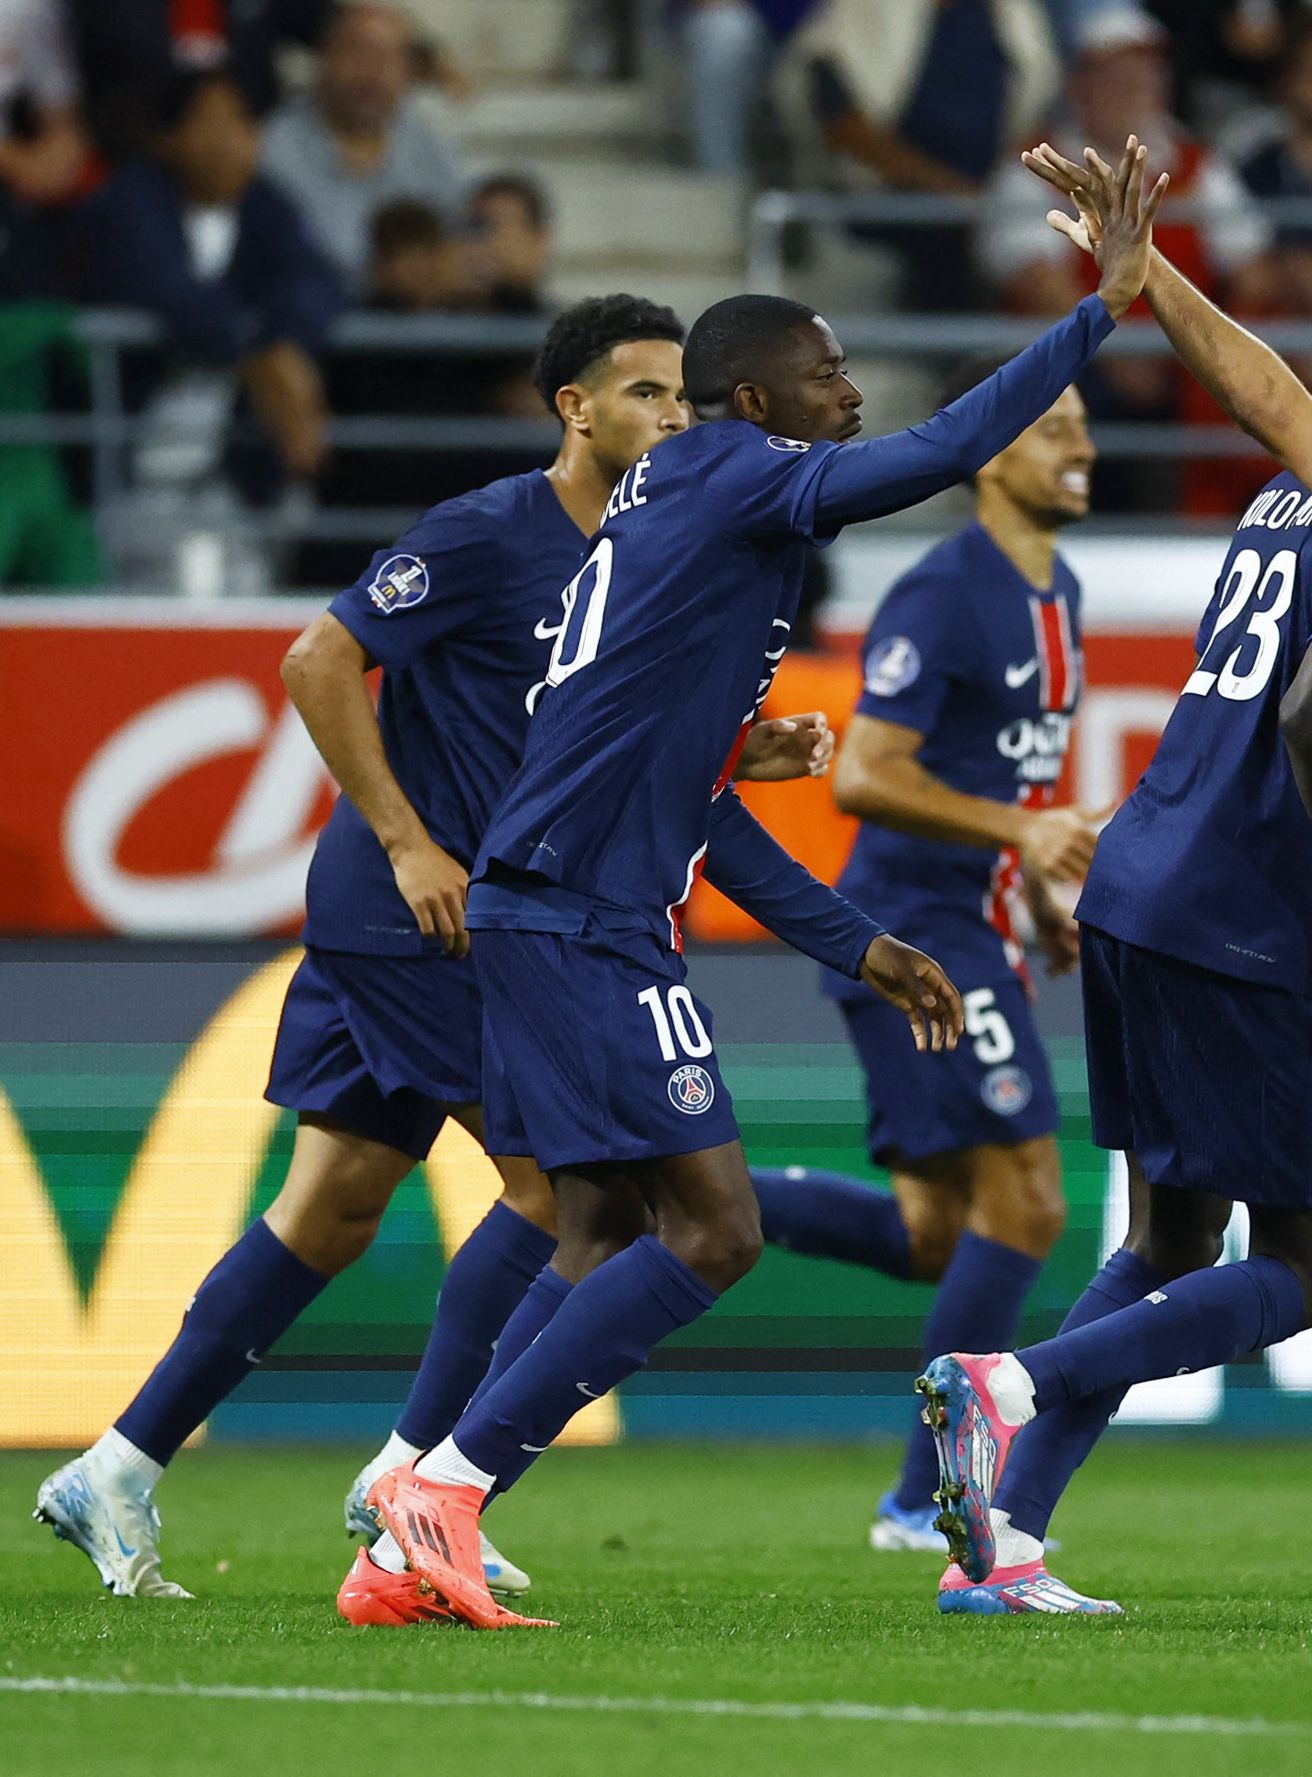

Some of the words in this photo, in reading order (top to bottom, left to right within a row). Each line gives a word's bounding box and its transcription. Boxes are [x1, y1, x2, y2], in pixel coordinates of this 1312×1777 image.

[545, 537, 614, 688] 0
[1179, 548, 1298, 701] 23
[637, 984, 713, 1062] 10
[963, 986, 1015, 1064] 5
[672, 1066, 702, 1084] PARIS
